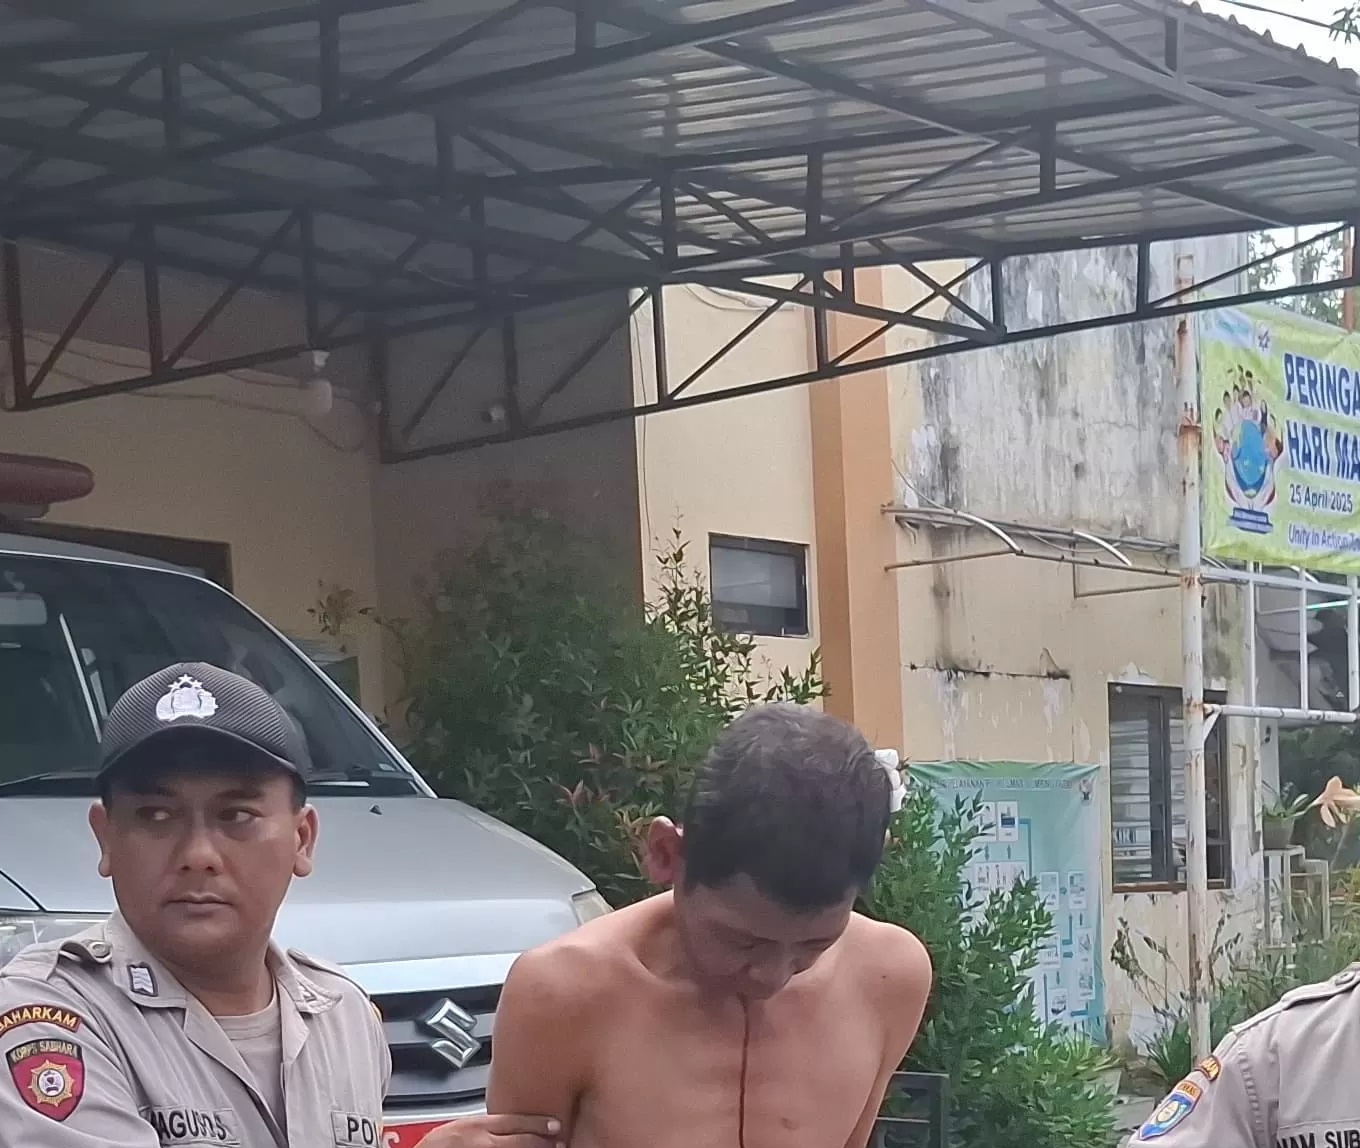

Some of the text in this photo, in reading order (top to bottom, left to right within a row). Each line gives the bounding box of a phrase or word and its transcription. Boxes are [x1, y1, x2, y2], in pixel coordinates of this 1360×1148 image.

[1286, 420, 1331, 476] HARI
[1289, 483, 1353, 514] 25 April 2025
